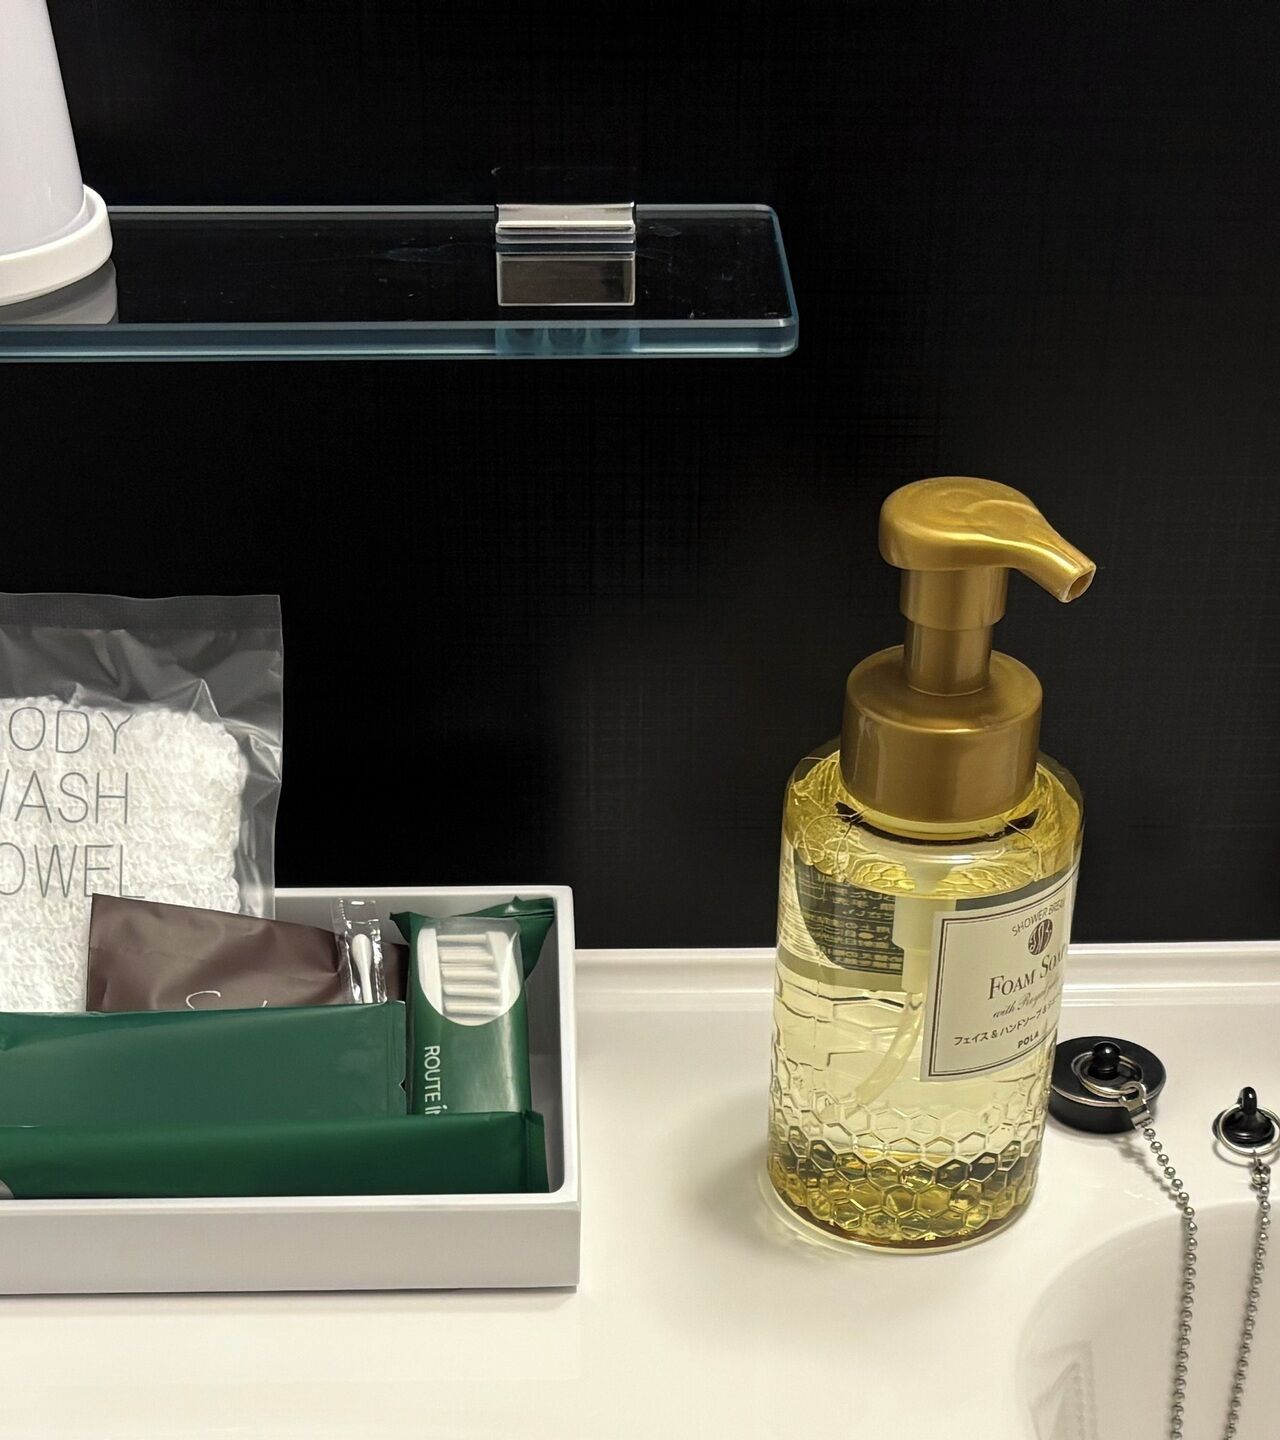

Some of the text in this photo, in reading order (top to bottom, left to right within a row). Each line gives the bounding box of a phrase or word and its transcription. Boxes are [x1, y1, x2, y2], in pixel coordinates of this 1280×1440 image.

[1011, 909, 1048, 937] SHOWER
[1017, 1030, 1040, 1049] POLA
[424, 1045, 441, 1103] ROUTE
